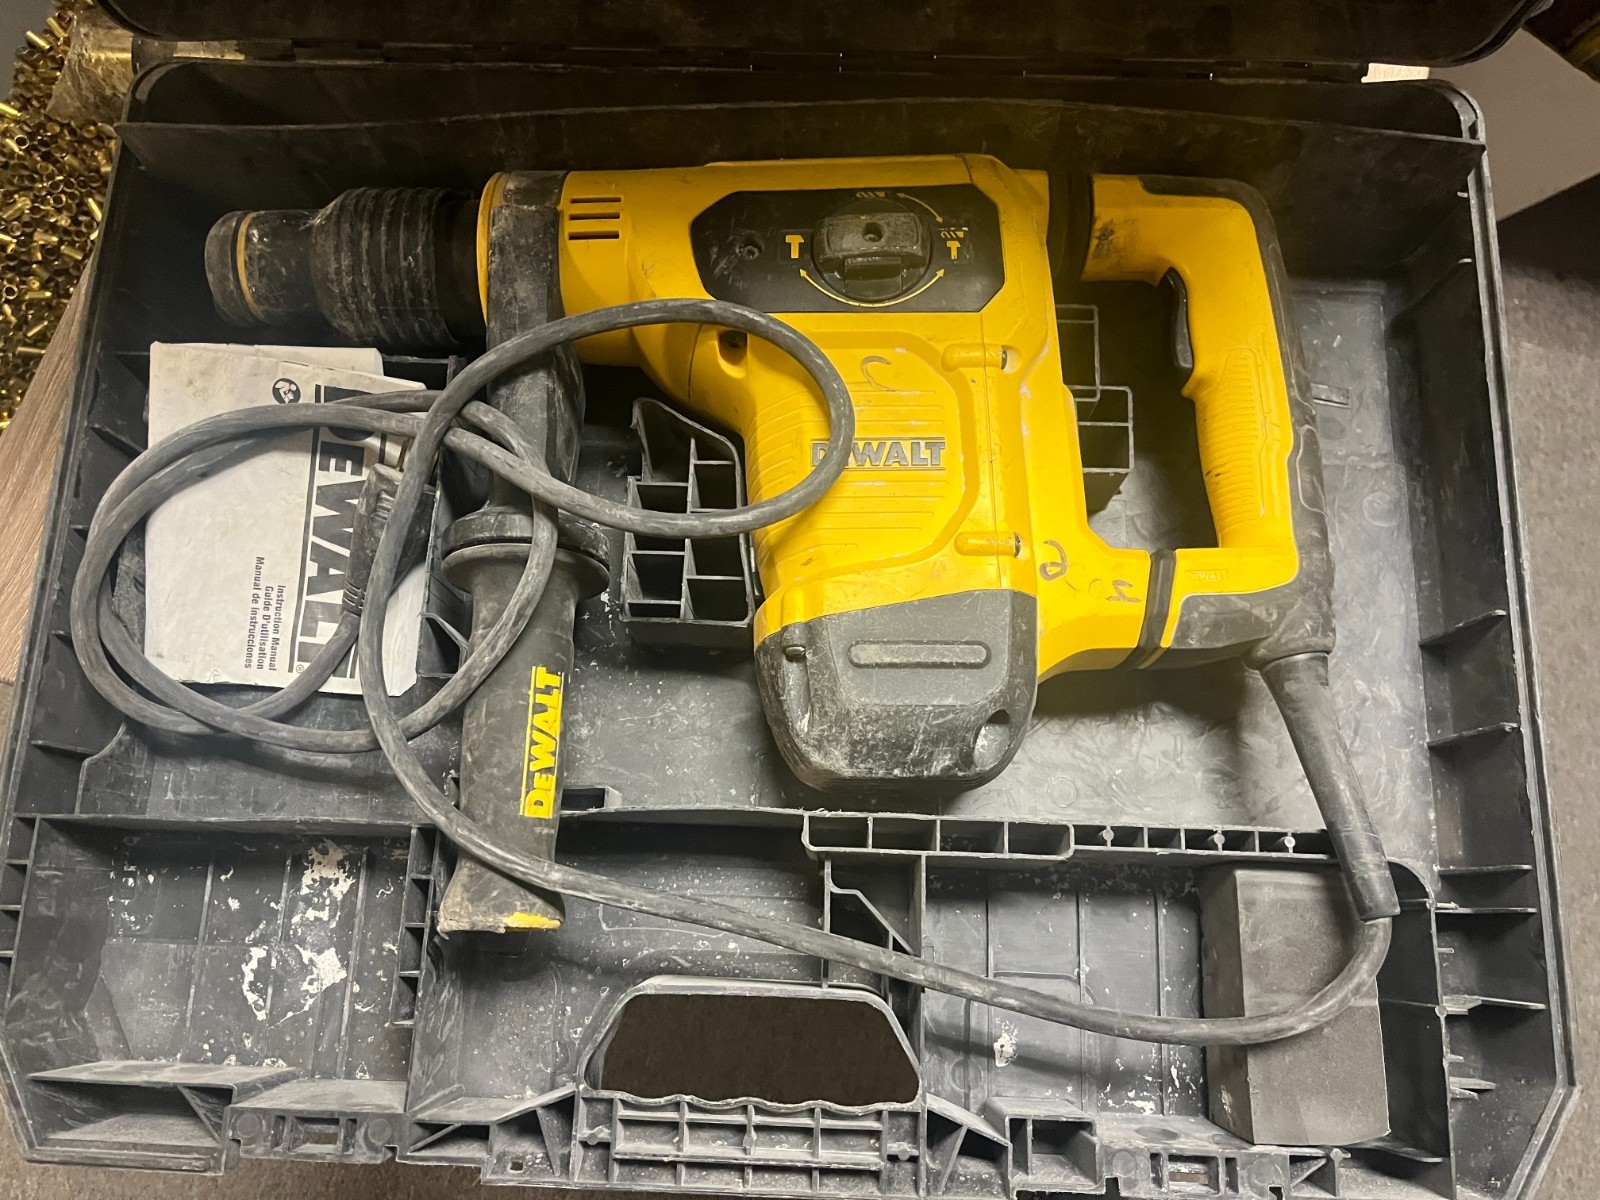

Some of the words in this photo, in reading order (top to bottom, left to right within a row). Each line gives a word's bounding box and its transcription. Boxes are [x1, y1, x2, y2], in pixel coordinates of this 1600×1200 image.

[811, 441, 946, 467] DWALT
[253, 556, 265, 590] Manual
[251, 593, 261, 604] de
[263, 585, 274, 611] Guide
[273, 585, 287, 635] Instruction
[256, 614, 271, 670] D'utilisation
[269, 637, 281, 671] Manual
[523, 665, 563, 818] DEWALT
